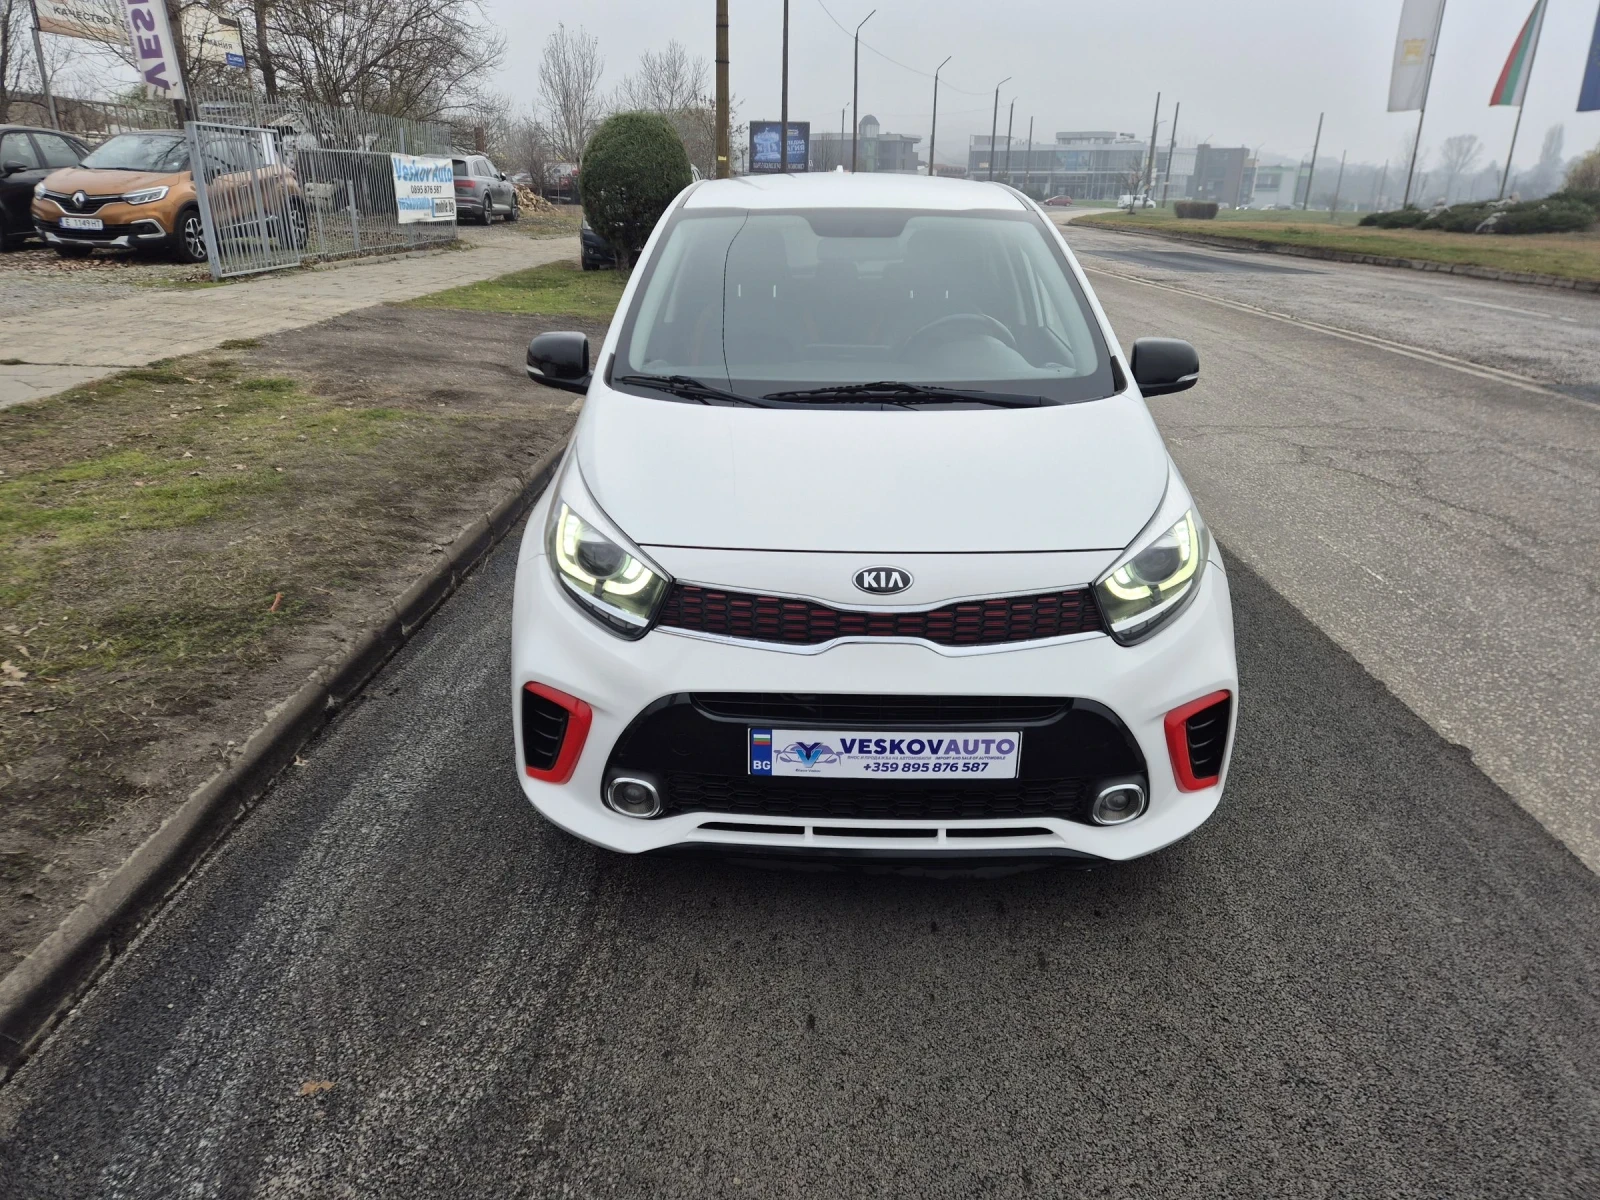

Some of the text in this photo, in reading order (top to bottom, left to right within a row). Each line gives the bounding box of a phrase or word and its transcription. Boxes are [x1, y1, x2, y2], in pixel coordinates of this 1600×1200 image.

[53, 7, 110, 25] КАЧЕСТВО
[393, 157, 453, 183] Veskov Auto
[410, 185, 442, 194] 0895 876 587
[862, 571, 904, 588] KIA
[840, 738, 1015, 755] VESKOVAUTO
[753, 760, 771, 770] BG
[863, 762, 989, 773] +359 895 876 587
